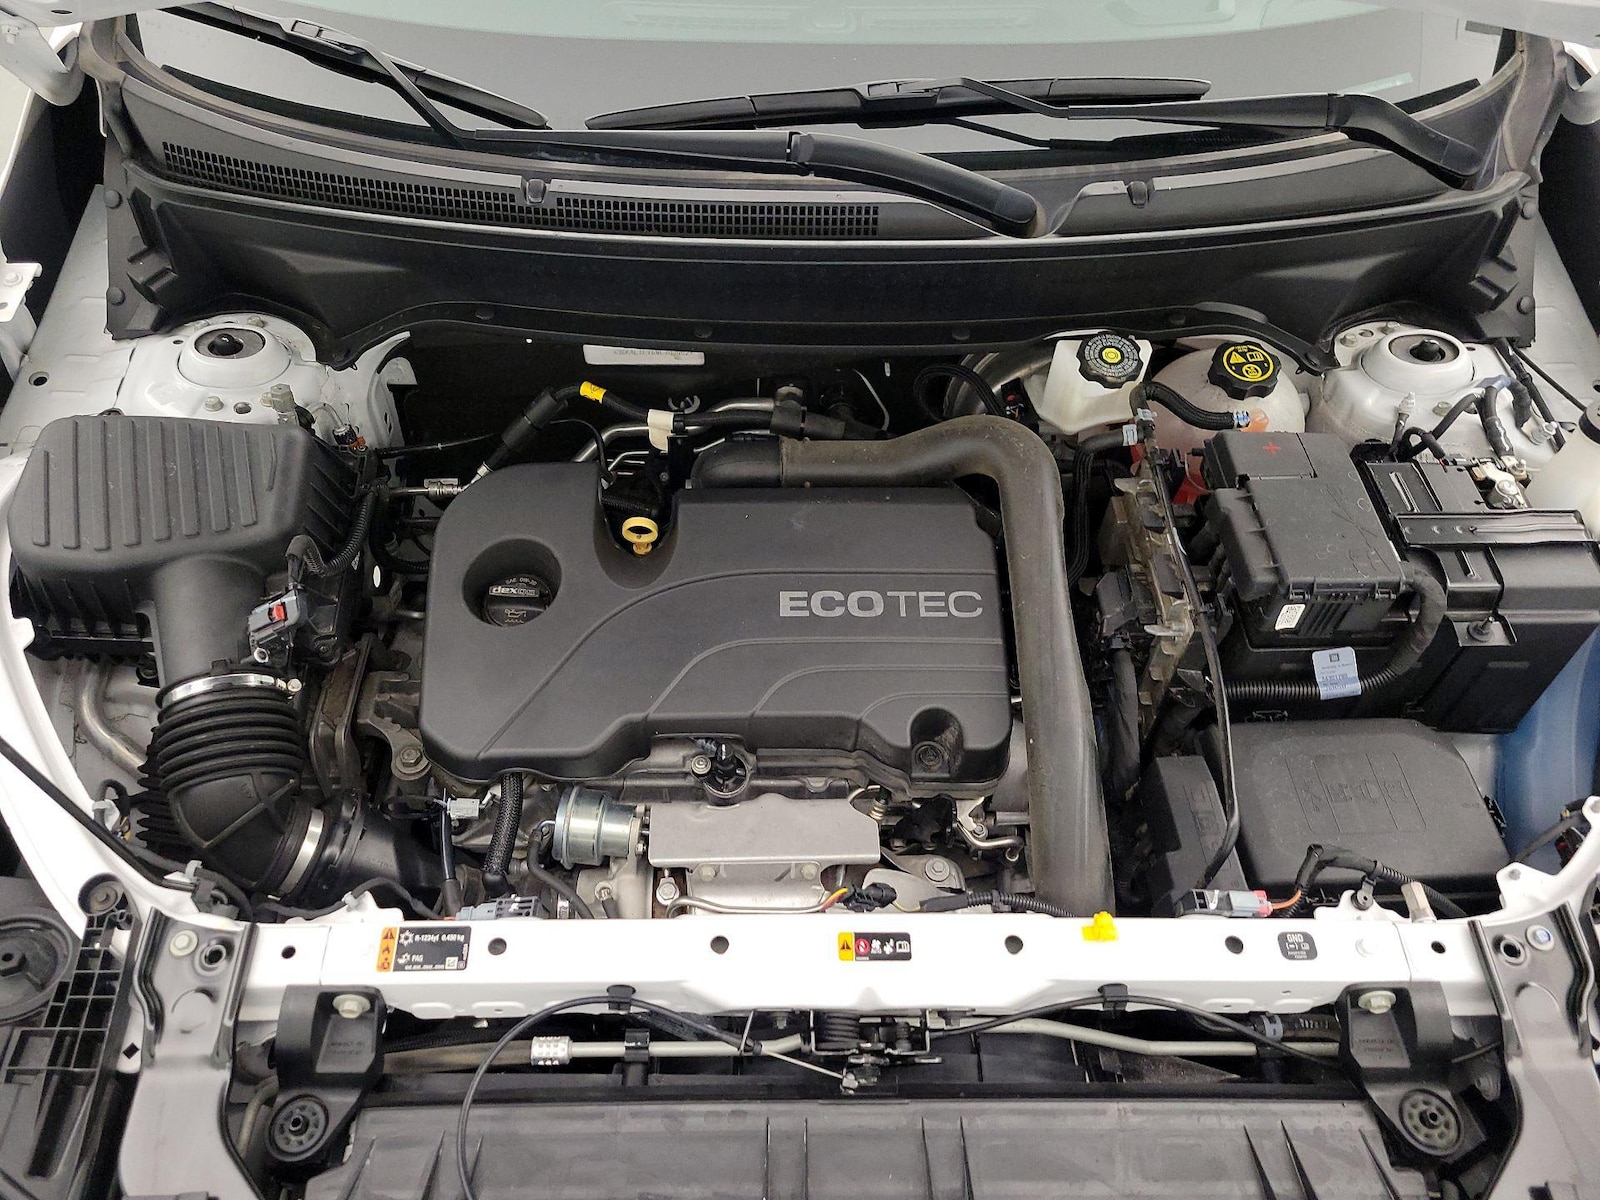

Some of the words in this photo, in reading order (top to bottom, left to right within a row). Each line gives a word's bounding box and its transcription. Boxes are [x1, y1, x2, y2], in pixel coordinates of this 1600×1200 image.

[780, 591, 983, 617] ECOTEC
[1286, 933, 1304, 943] GND
[411, 955, 424, 963] PAG
